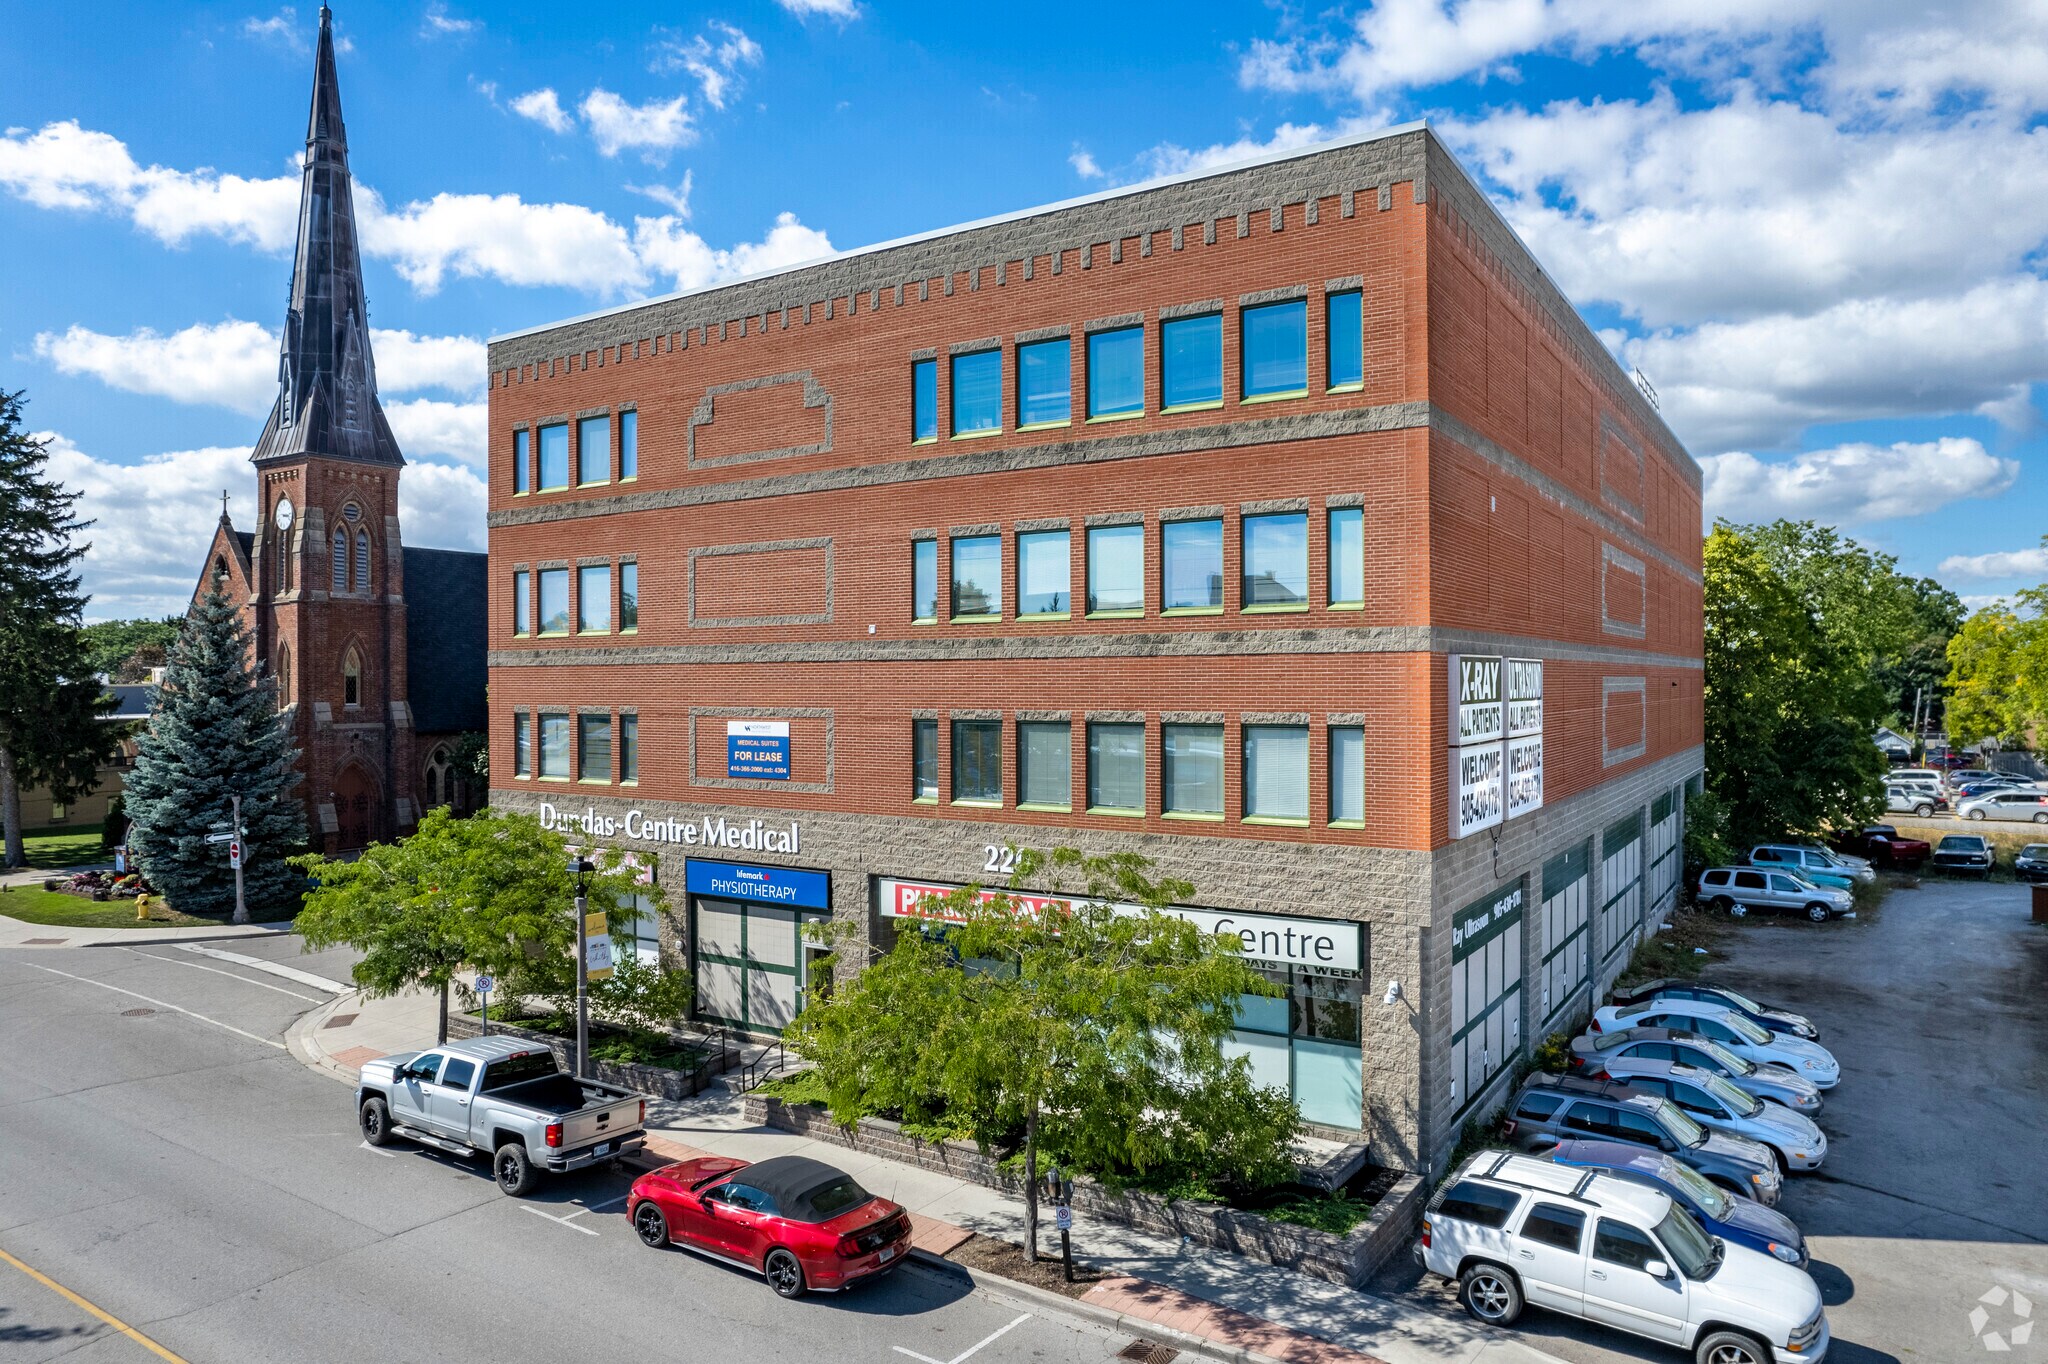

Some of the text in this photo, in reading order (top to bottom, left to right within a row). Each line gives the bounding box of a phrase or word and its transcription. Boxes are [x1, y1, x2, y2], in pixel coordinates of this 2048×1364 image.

[1461, 661, 1499, 701] X-RAY
[1508, 661, 1541, 700] ULTRASOUND
[1460, 705, 1500, 738] ALL PATIENTS
[1510, 704, 1541, 731] ALL PATIENTS
[734, 751, 782, 762] FOR LEASE
[1461, 750, 1500, 786] WELCOME
[1510, 743, 1541, 775] WELCOME
[702, 816, 799, 853] Medical
[984, 845, 1024, 873] 22
[711, 878, 797, 900] PHYSIOTHERAPY
[736, 869, 763, 880] lifemark
[1297, 964, 1309, 973] A
[1313, 966, 1362, 980] WEEK
